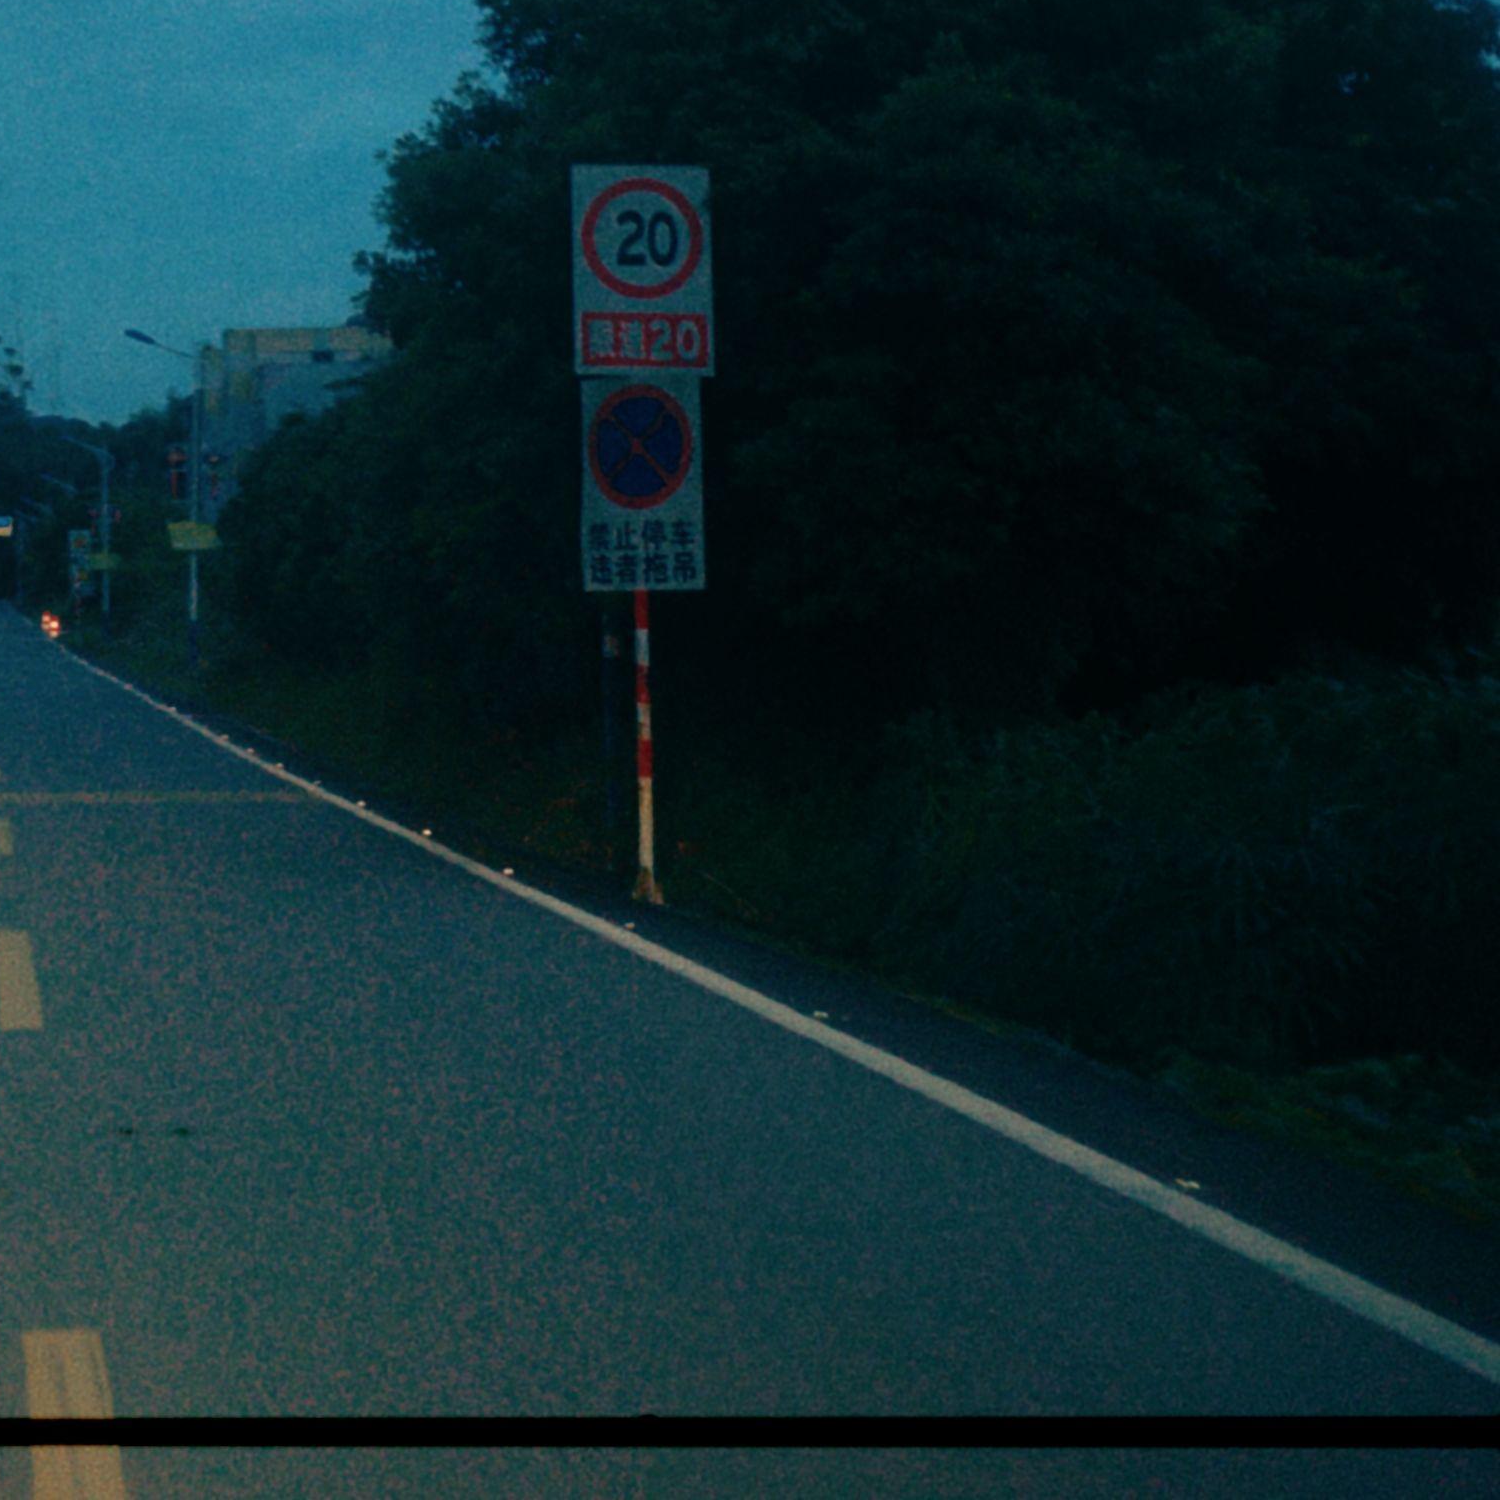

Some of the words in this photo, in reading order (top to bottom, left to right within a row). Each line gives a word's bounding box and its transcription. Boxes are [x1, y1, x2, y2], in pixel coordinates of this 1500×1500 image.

[617, 210, 678, 266] 20
[588, 519, 695, 551] 禁止停车
